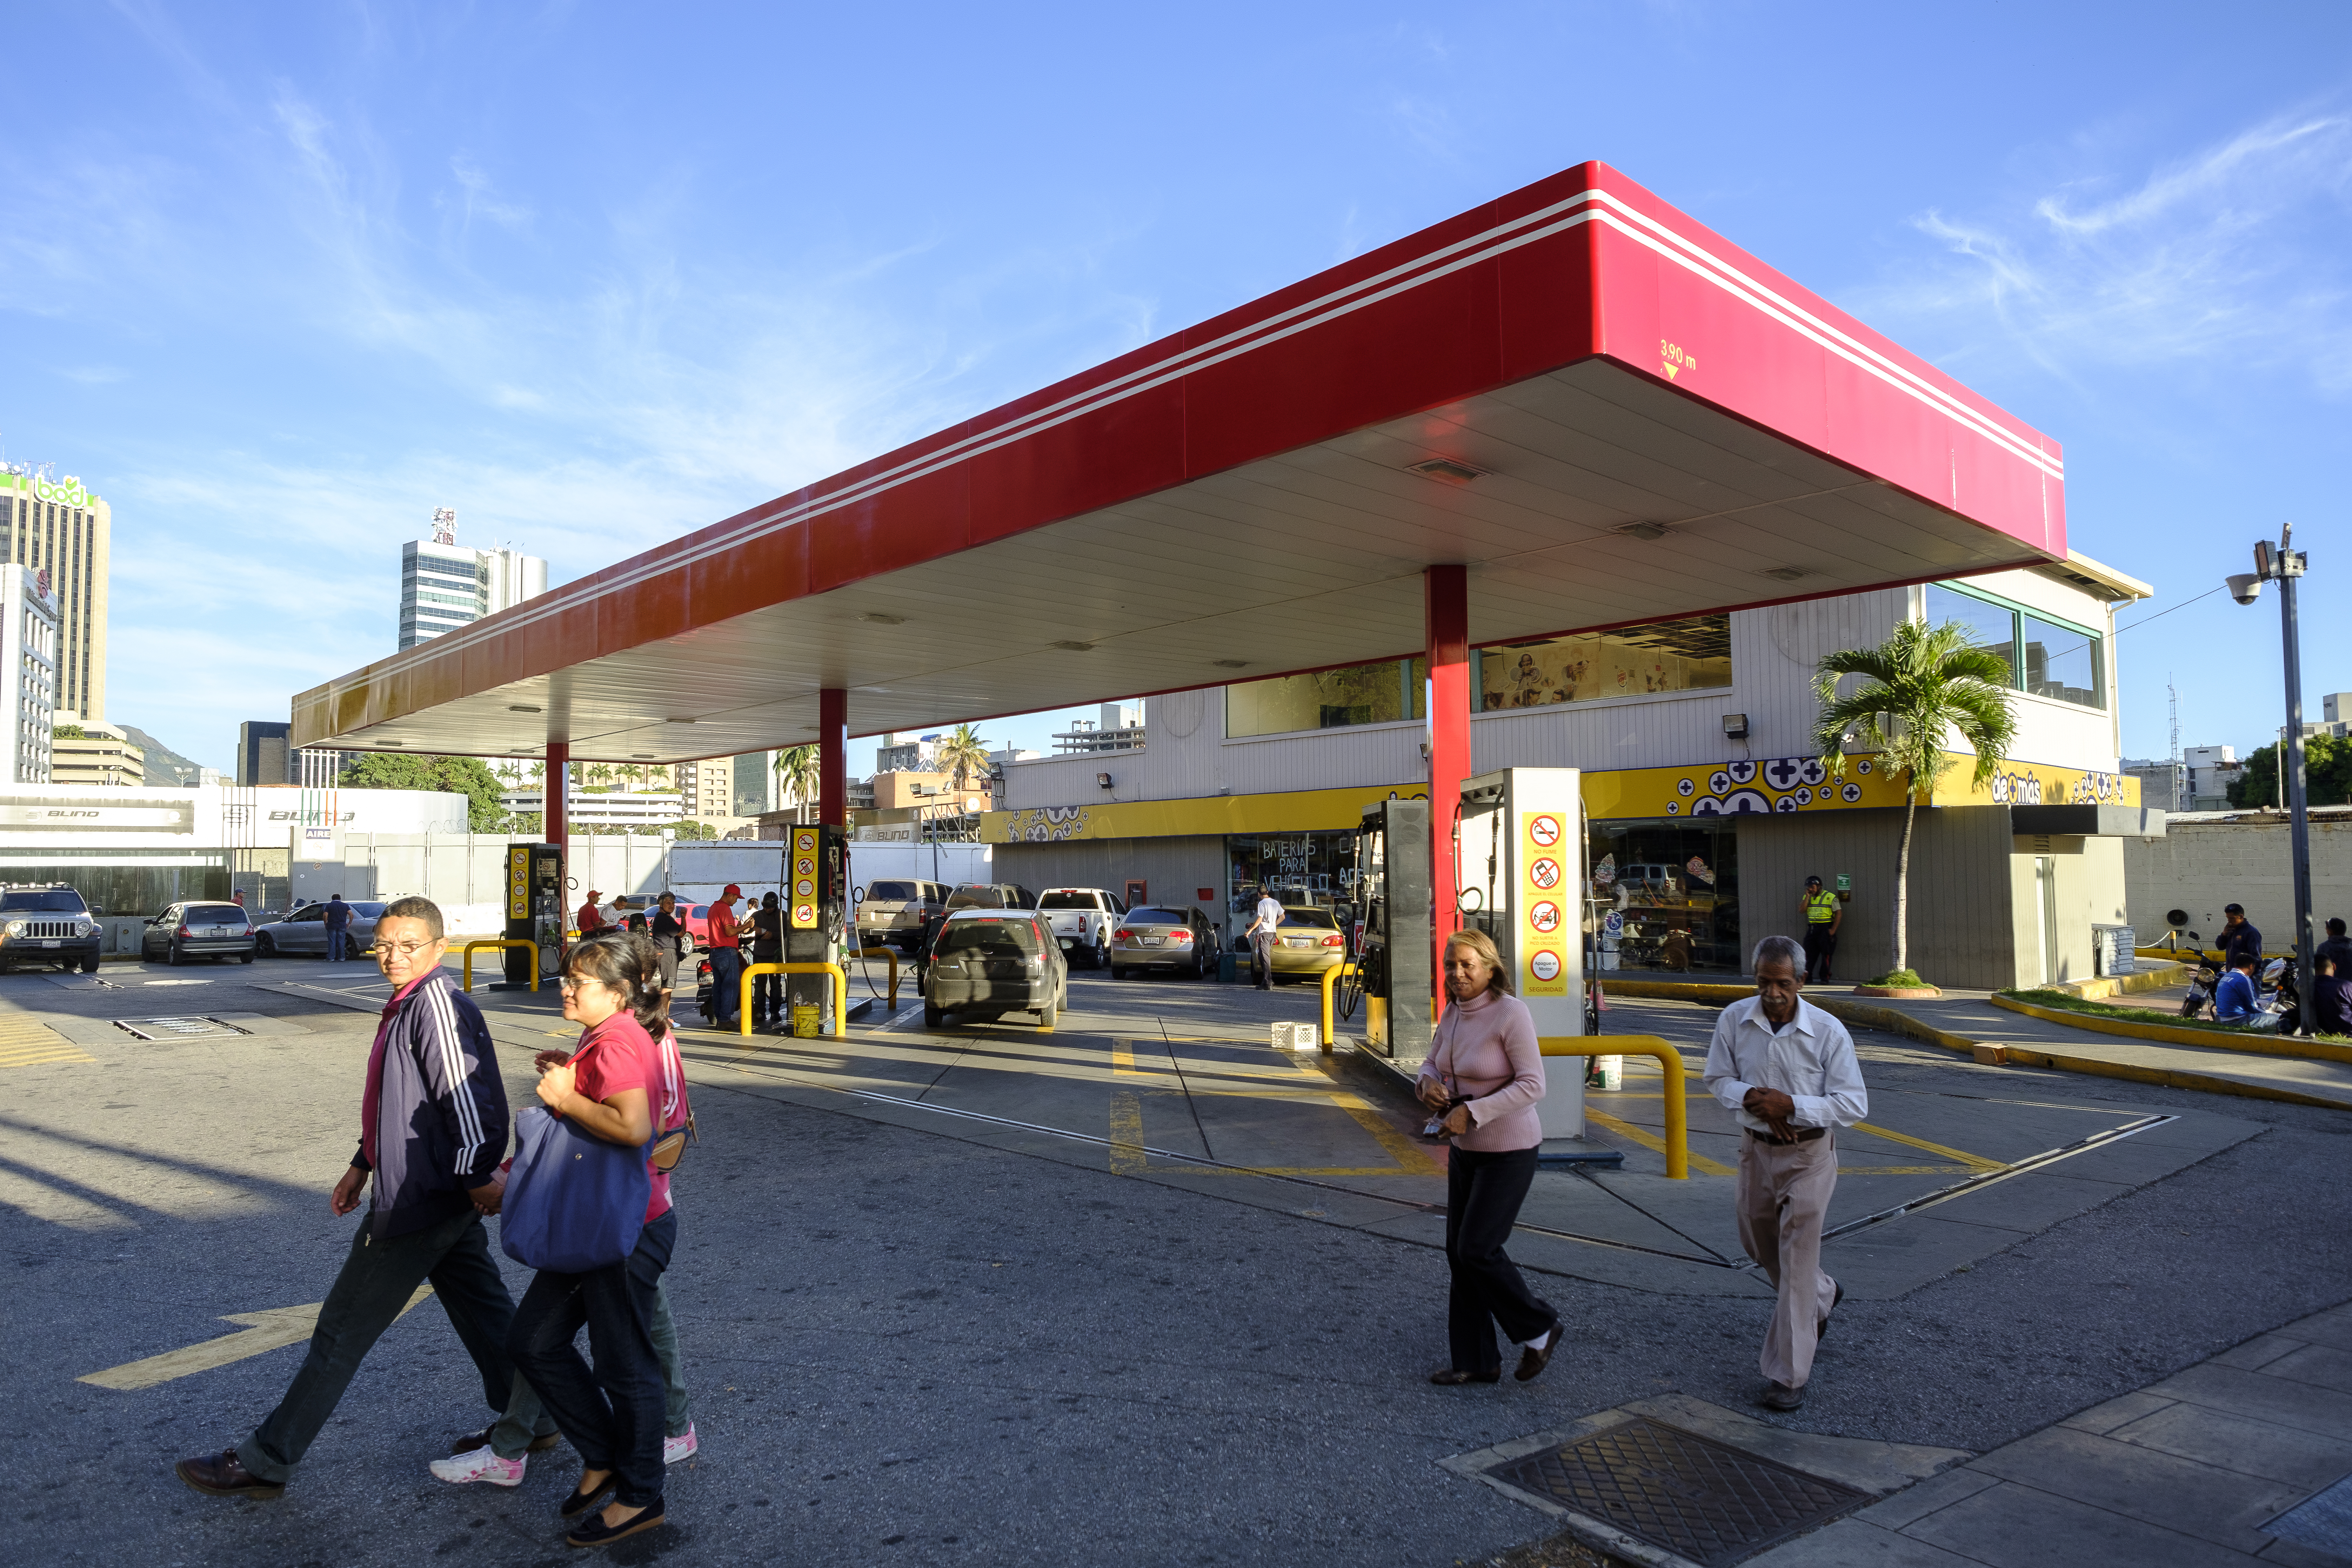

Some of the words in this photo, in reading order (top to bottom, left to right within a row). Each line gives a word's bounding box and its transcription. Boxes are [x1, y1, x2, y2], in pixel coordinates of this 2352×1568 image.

[1661, 339, 1683, 363] 3,90
[1686, 355, 1696, 370] m
[1263, 838, 1316, 859] BATERÍAS
[1279, 857, 1306, 873] PARA
